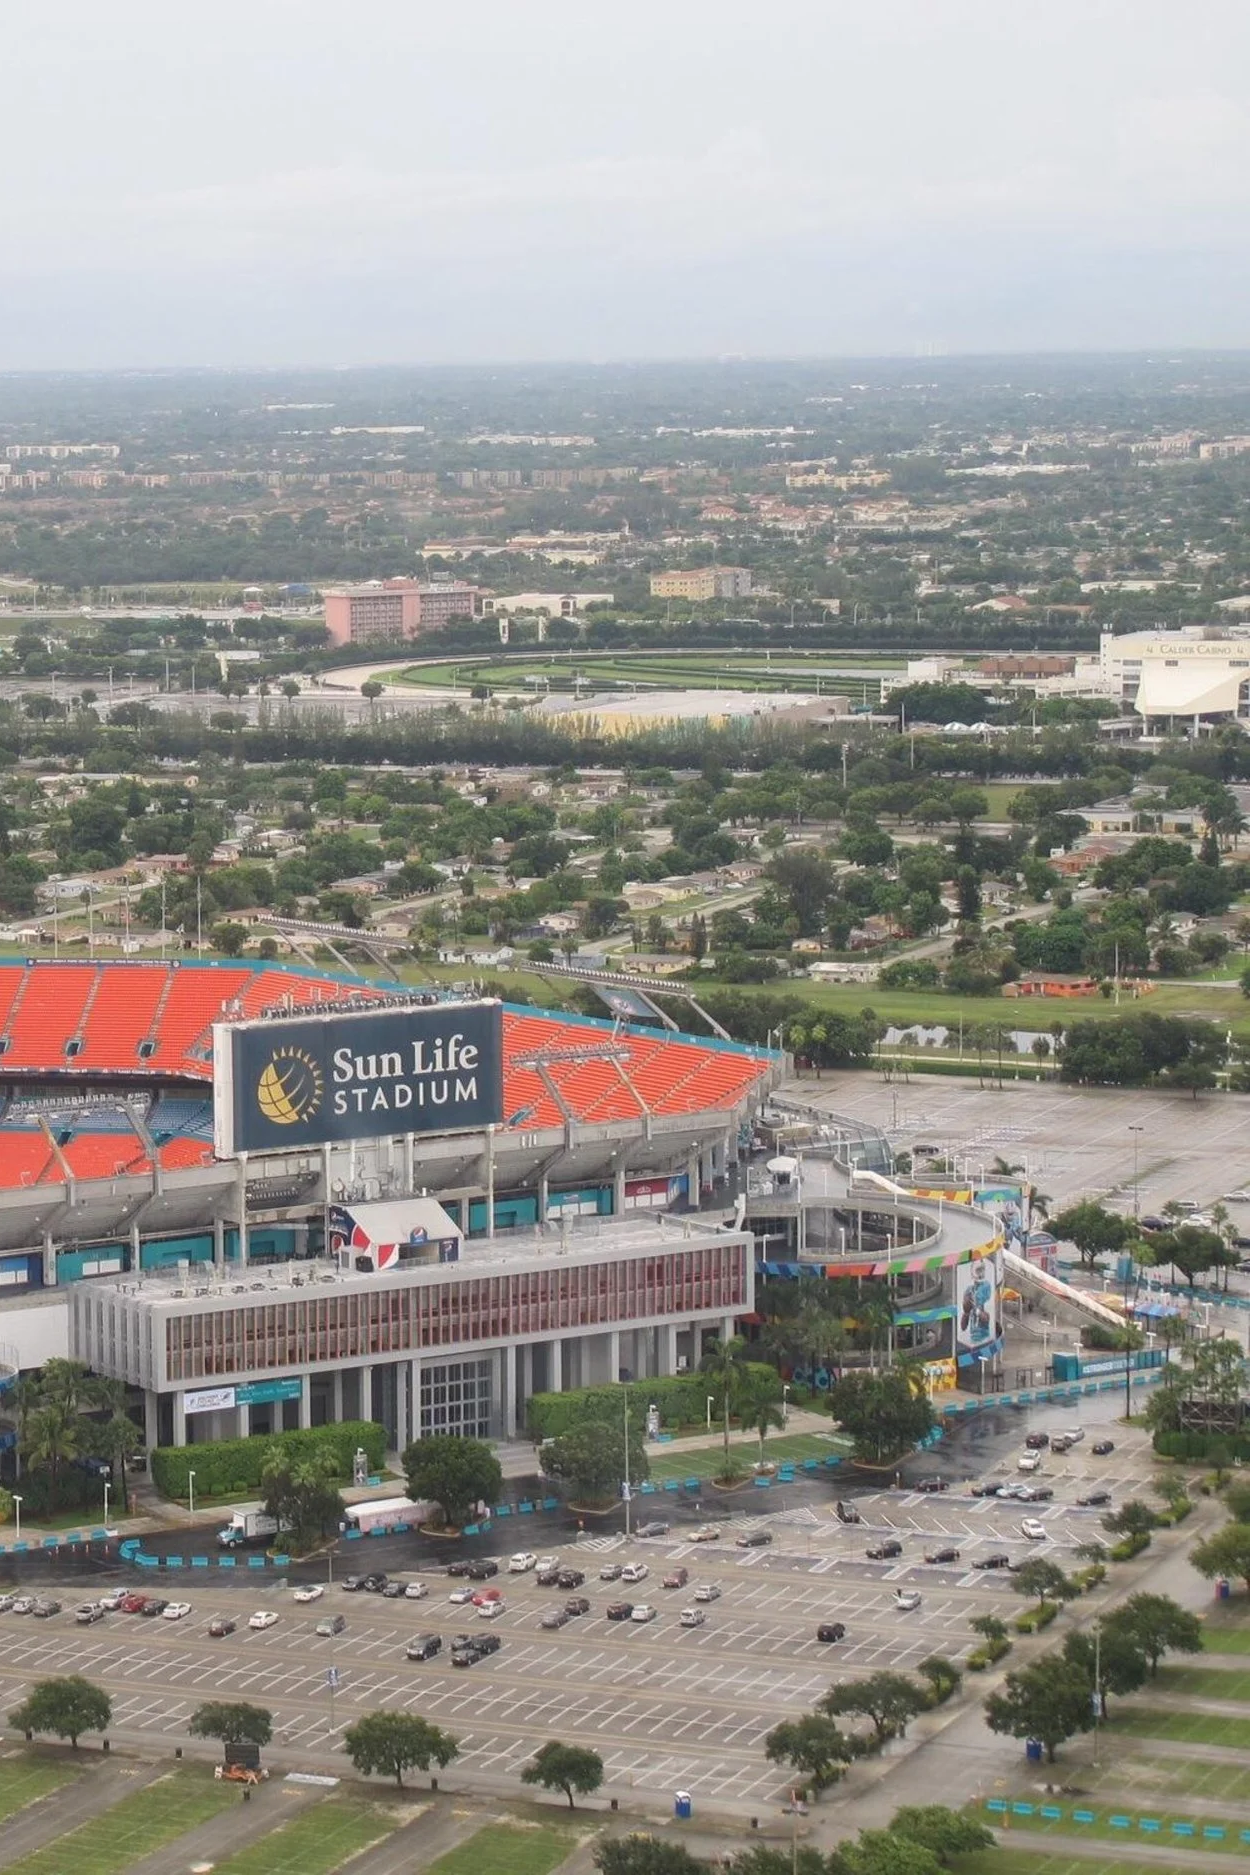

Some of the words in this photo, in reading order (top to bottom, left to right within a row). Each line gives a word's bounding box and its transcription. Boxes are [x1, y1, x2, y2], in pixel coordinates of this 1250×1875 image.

[332, 1047, 404, 1084] Sun
[411, 1033, 479, 1074] Life
[333, 1076, 478, 1115] STADIUM
